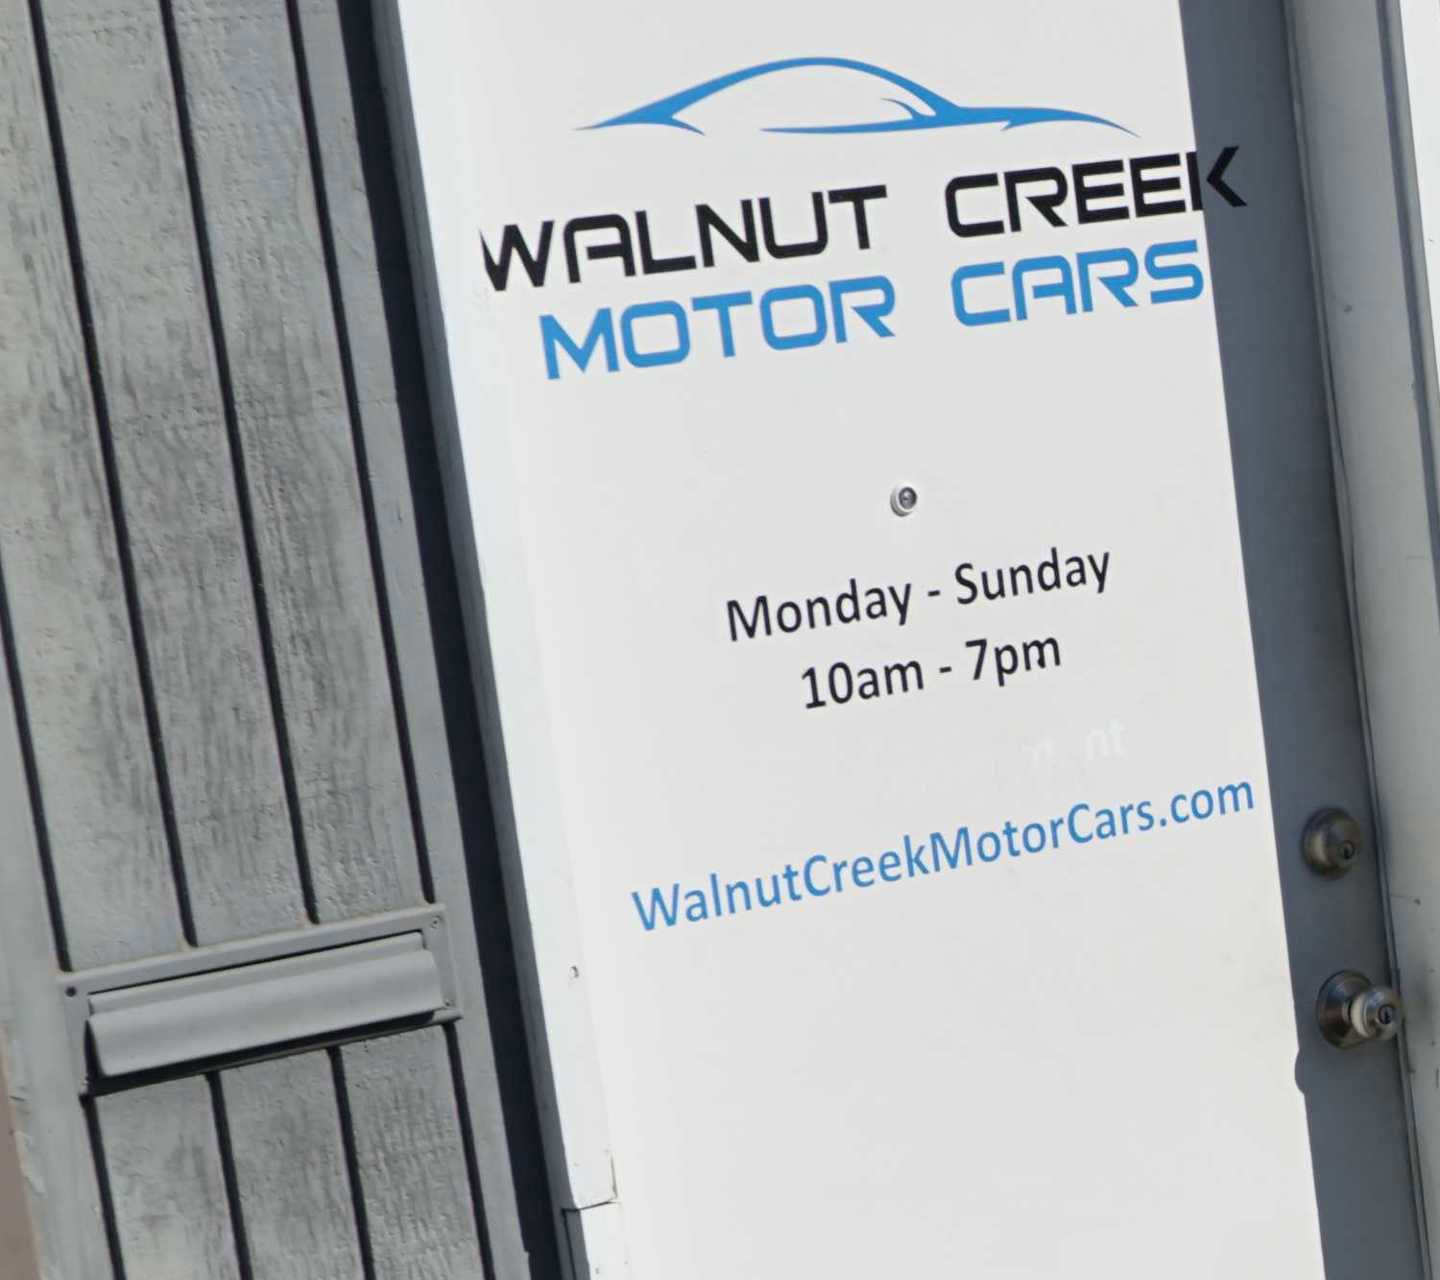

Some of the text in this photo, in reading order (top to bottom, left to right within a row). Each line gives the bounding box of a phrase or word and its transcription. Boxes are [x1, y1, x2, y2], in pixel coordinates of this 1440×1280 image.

[479, 145, 1248, 292] WALNUT CREEK
[539, 239, 1205, 380] MOTOR CARS
[726, 578, 912, 642] Monday
[954, 546, 1110, 605] Sunday
[801, 660, 924, 709] 10am
[965, 637, 1061, 687] 7pm
[632, 782, 1254, 930] WalnutCreekMotorCars.com
